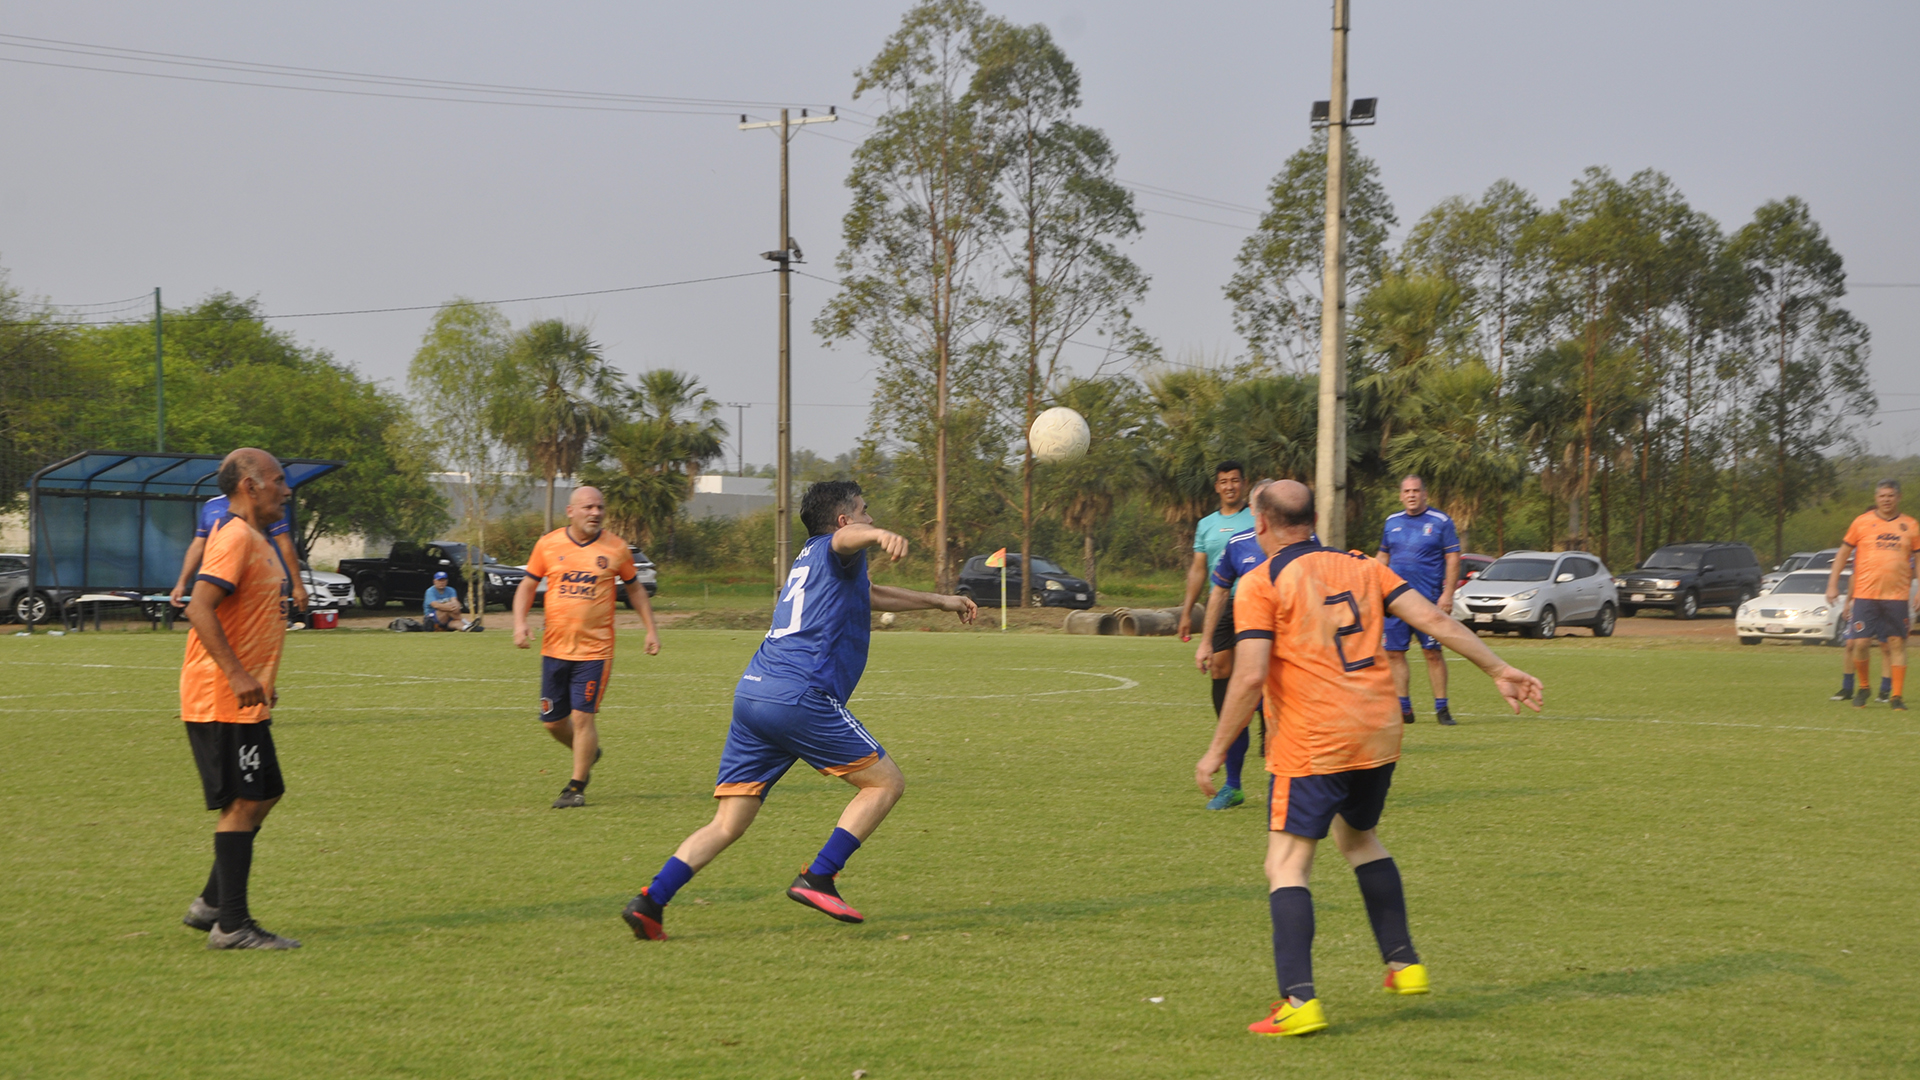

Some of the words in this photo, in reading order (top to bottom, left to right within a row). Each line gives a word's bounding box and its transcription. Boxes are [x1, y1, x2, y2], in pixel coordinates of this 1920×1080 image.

[561, 571, 598, 584] KTM
[765, 565, 810, 639] 3
[1323, 590, 1375, 672] 2
